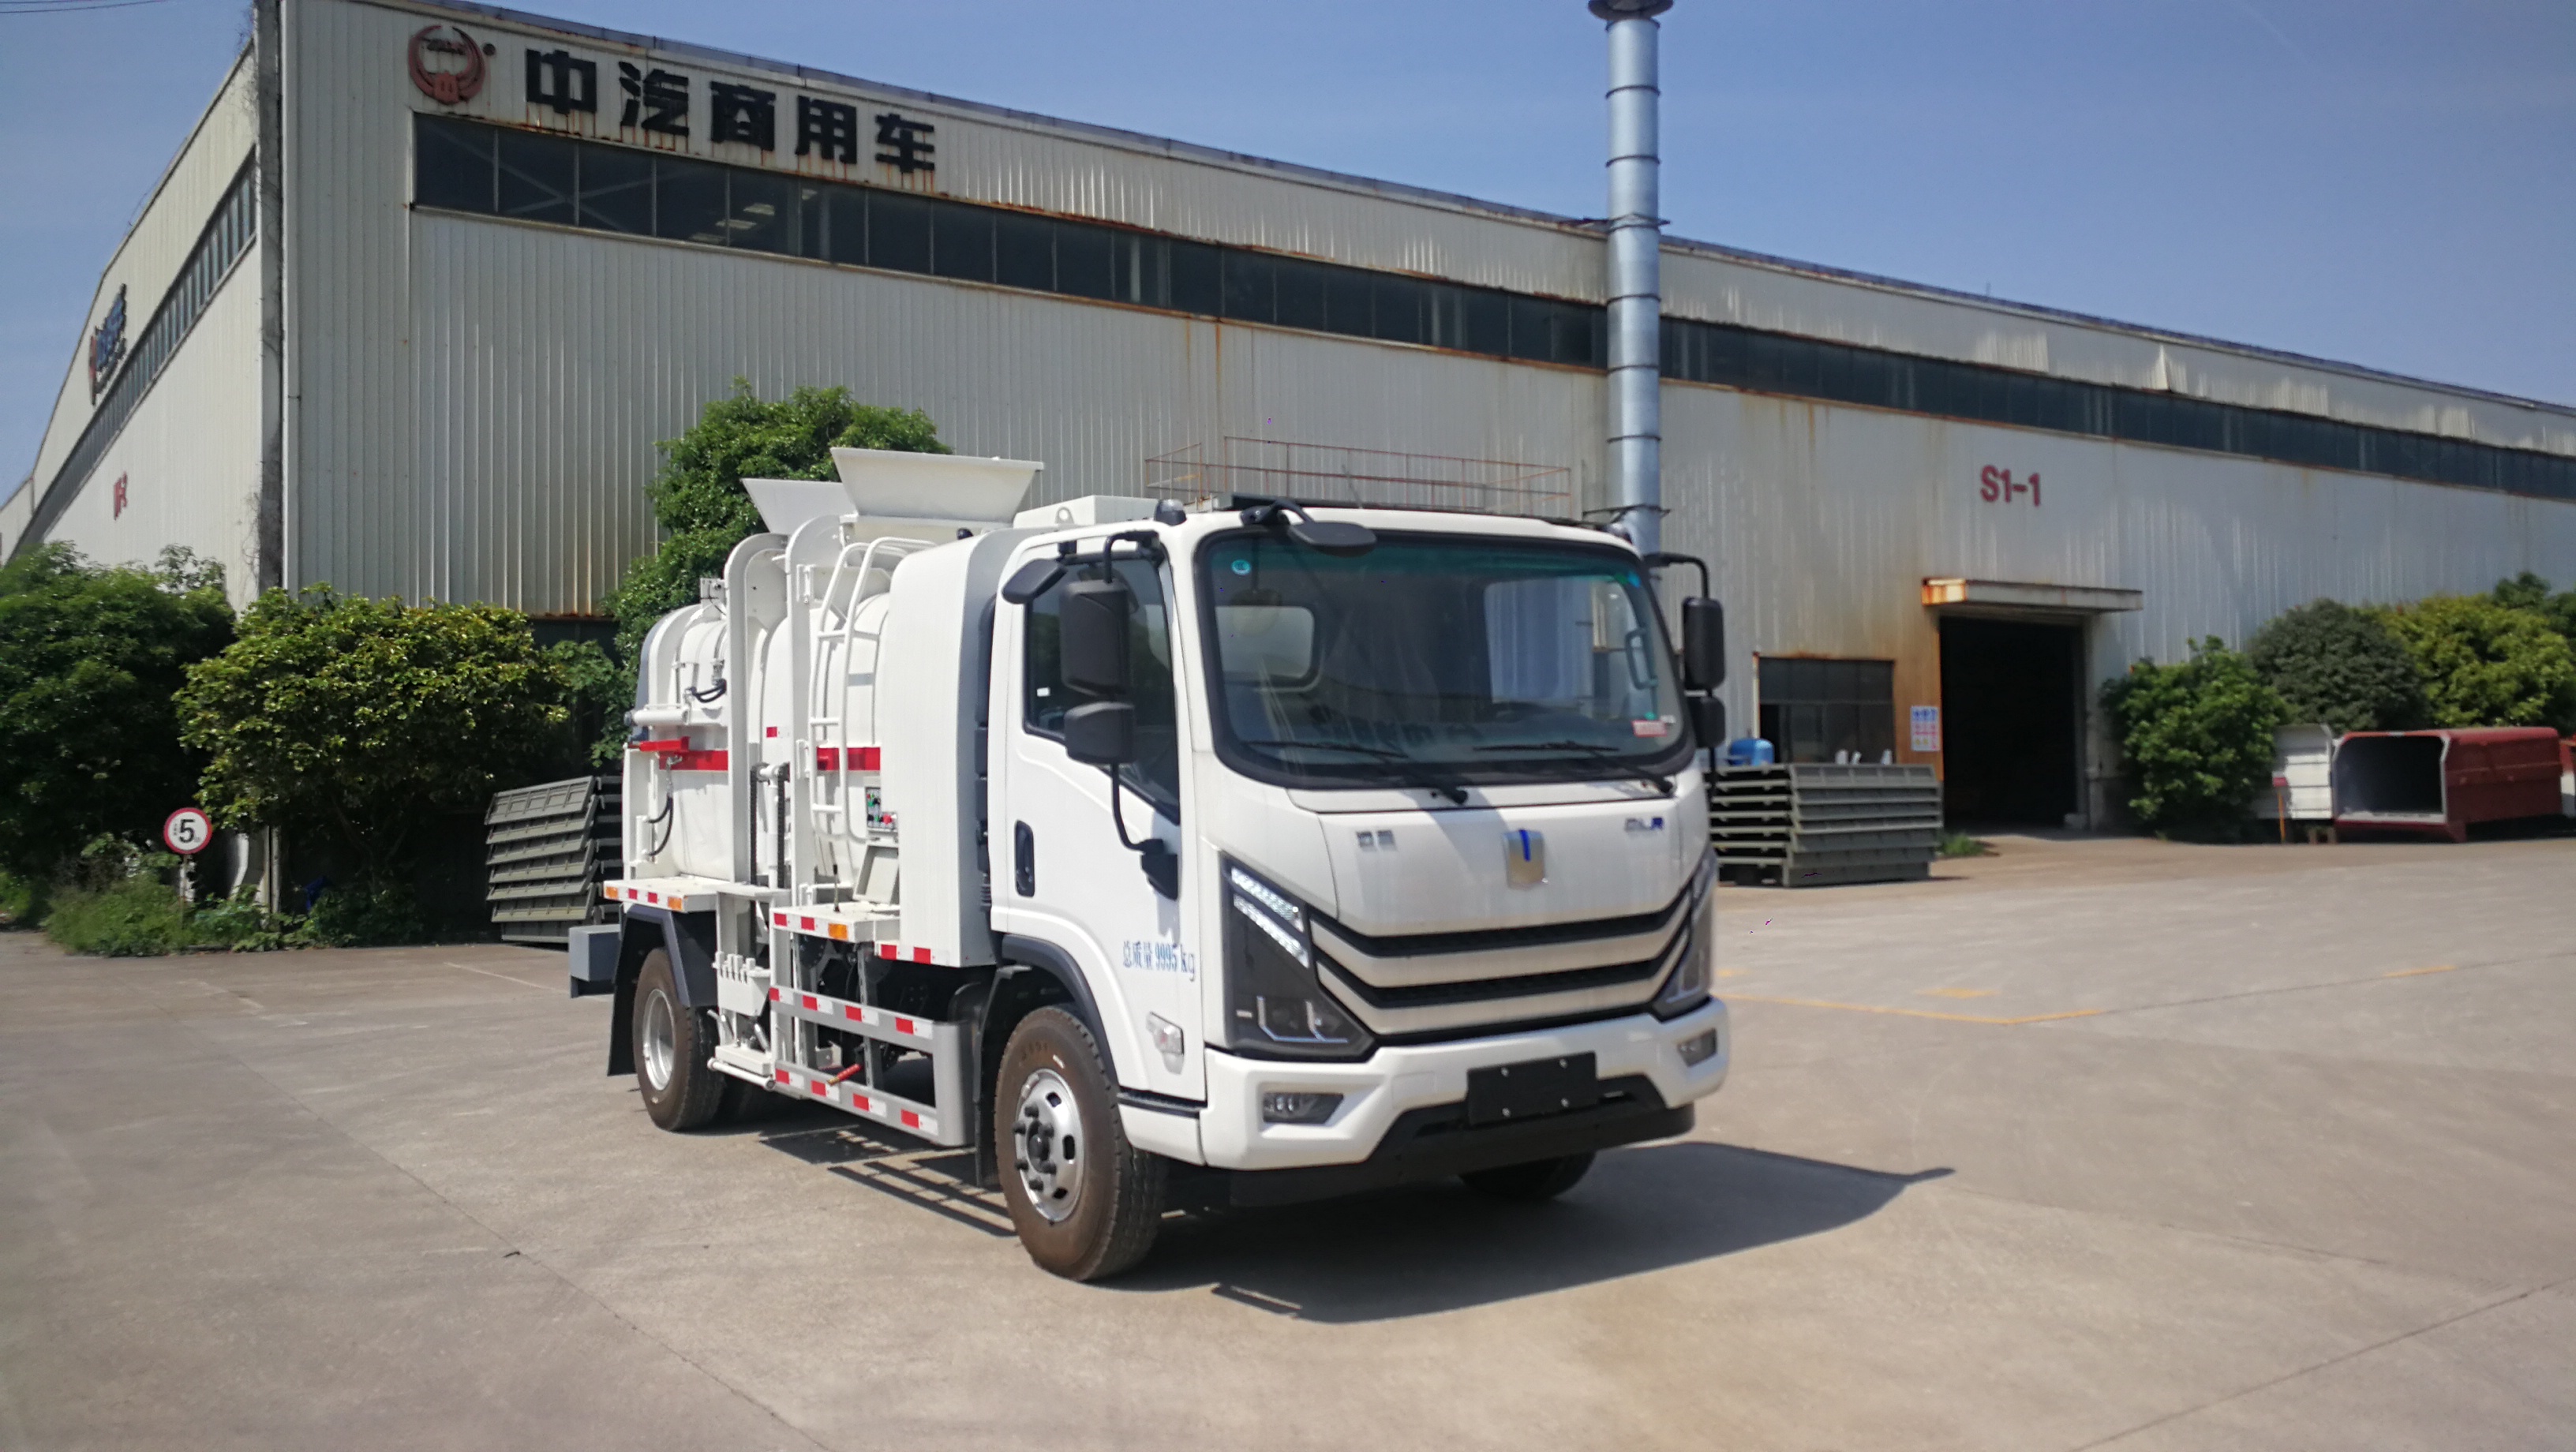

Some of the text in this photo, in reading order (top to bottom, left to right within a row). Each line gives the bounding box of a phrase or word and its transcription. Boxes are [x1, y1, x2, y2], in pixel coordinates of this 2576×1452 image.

[526, 49, 934, 173] 中汽商用车
[1980, 465, 2040, 507] S1-1
[179, 819, 195, 843] 5
